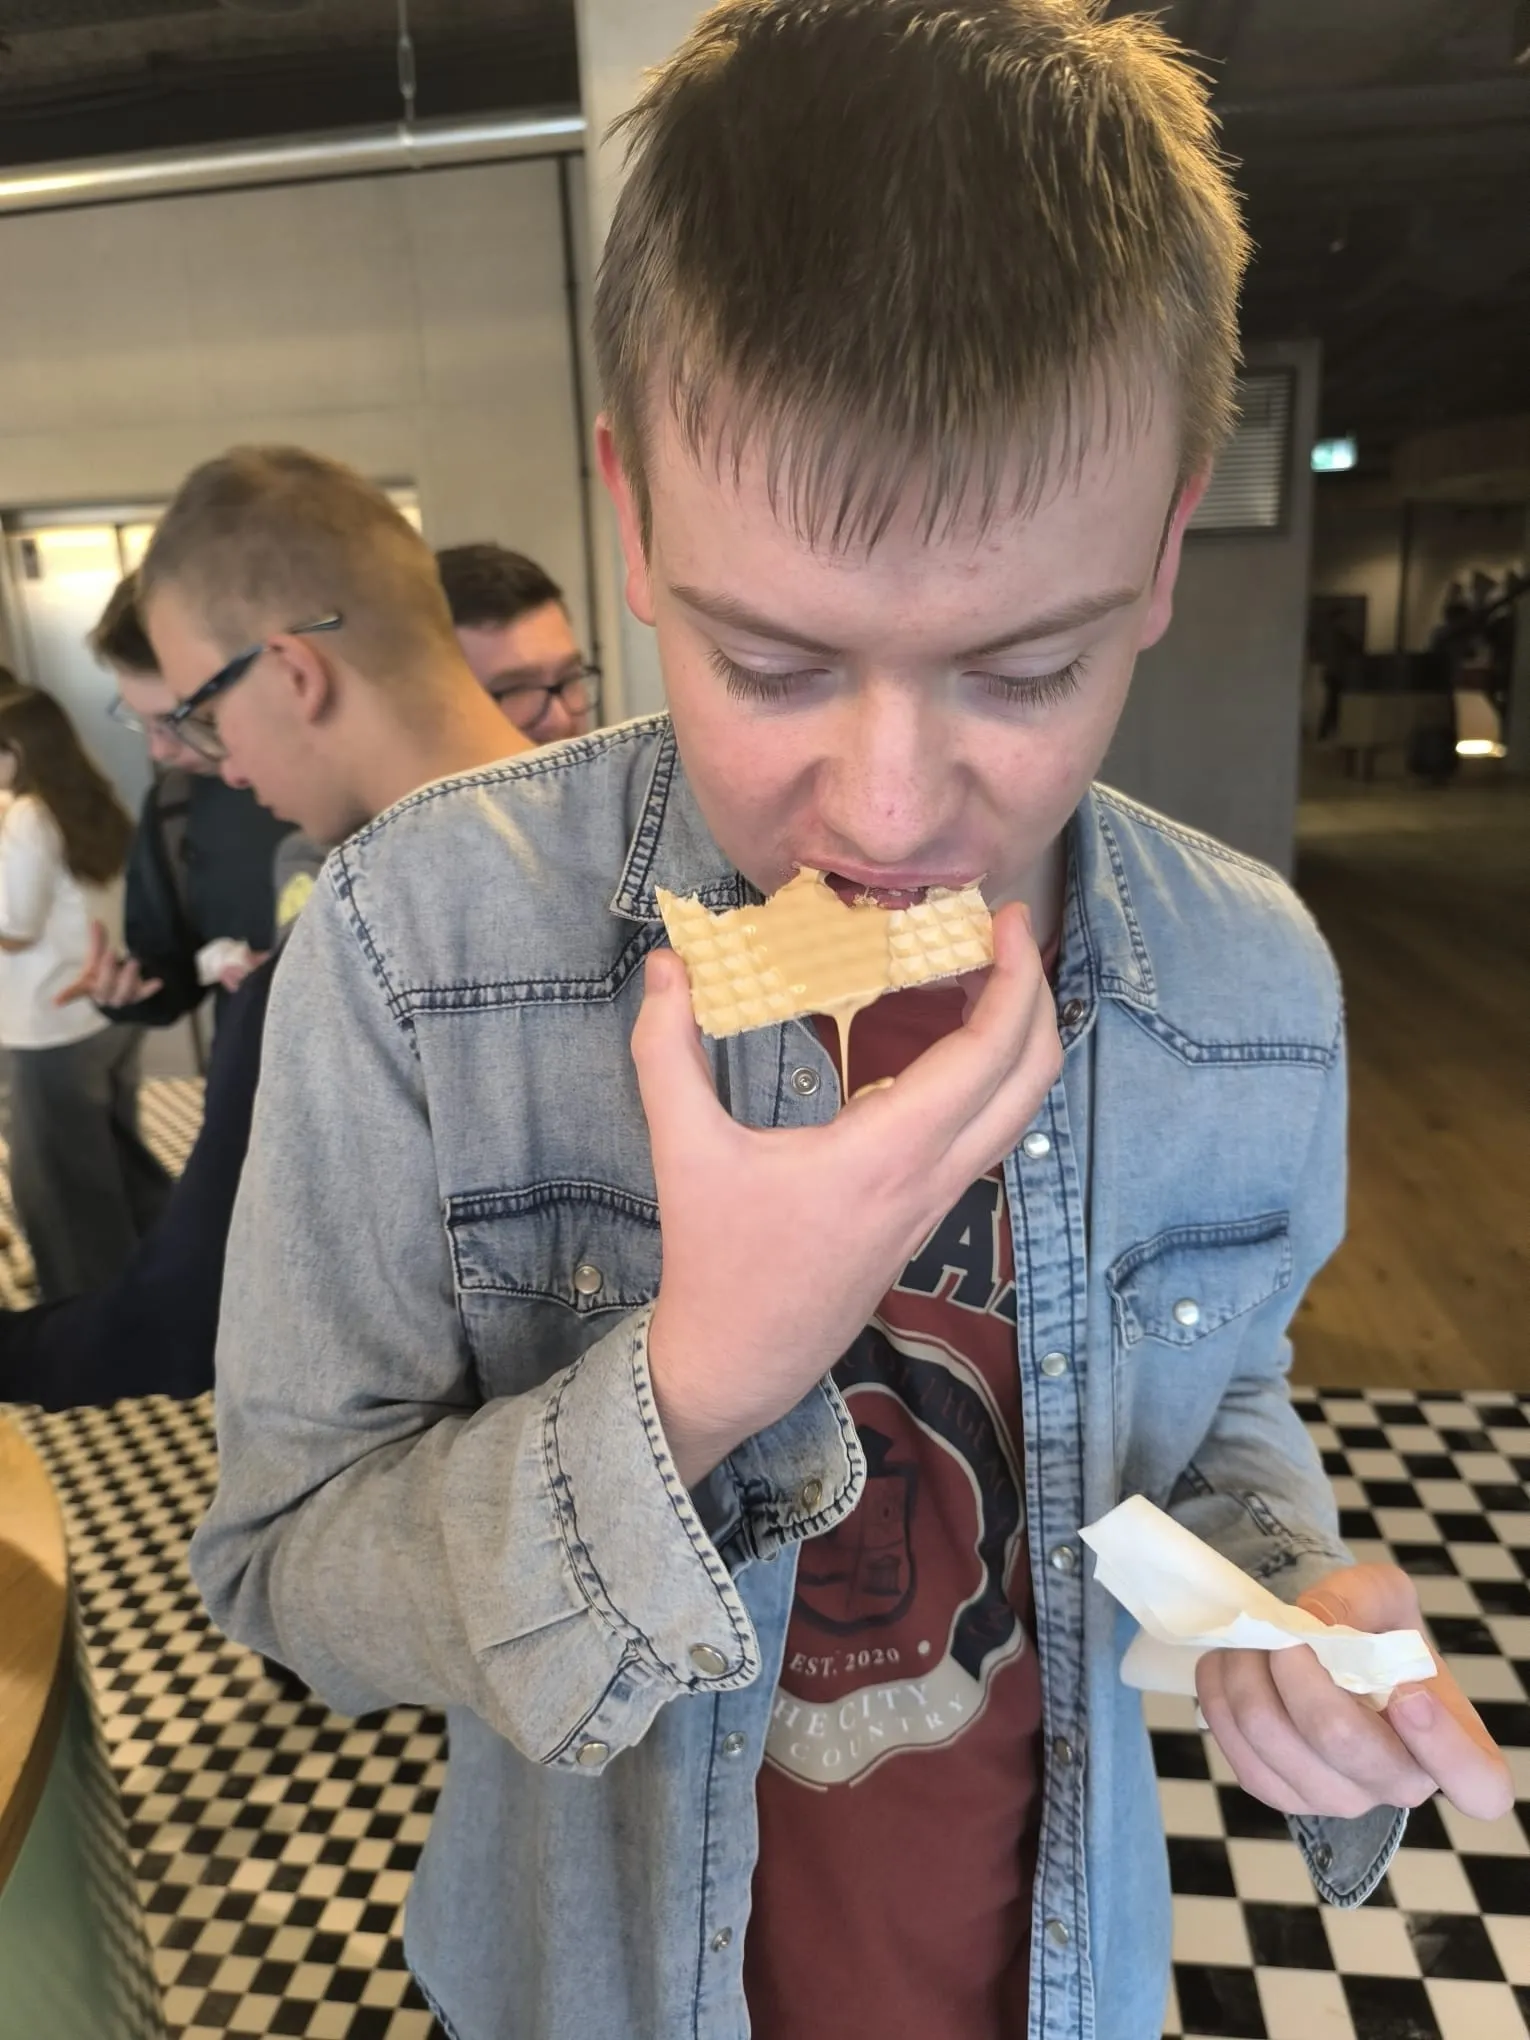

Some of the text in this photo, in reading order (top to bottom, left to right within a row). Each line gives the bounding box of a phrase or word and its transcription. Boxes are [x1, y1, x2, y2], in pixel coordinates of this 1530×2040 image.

[789, 1647, 900, 1678] EST. 2020
[773, 1683, 929, 1738] HE CITY
[789, 1693, 965, 1768] COUNTRY
